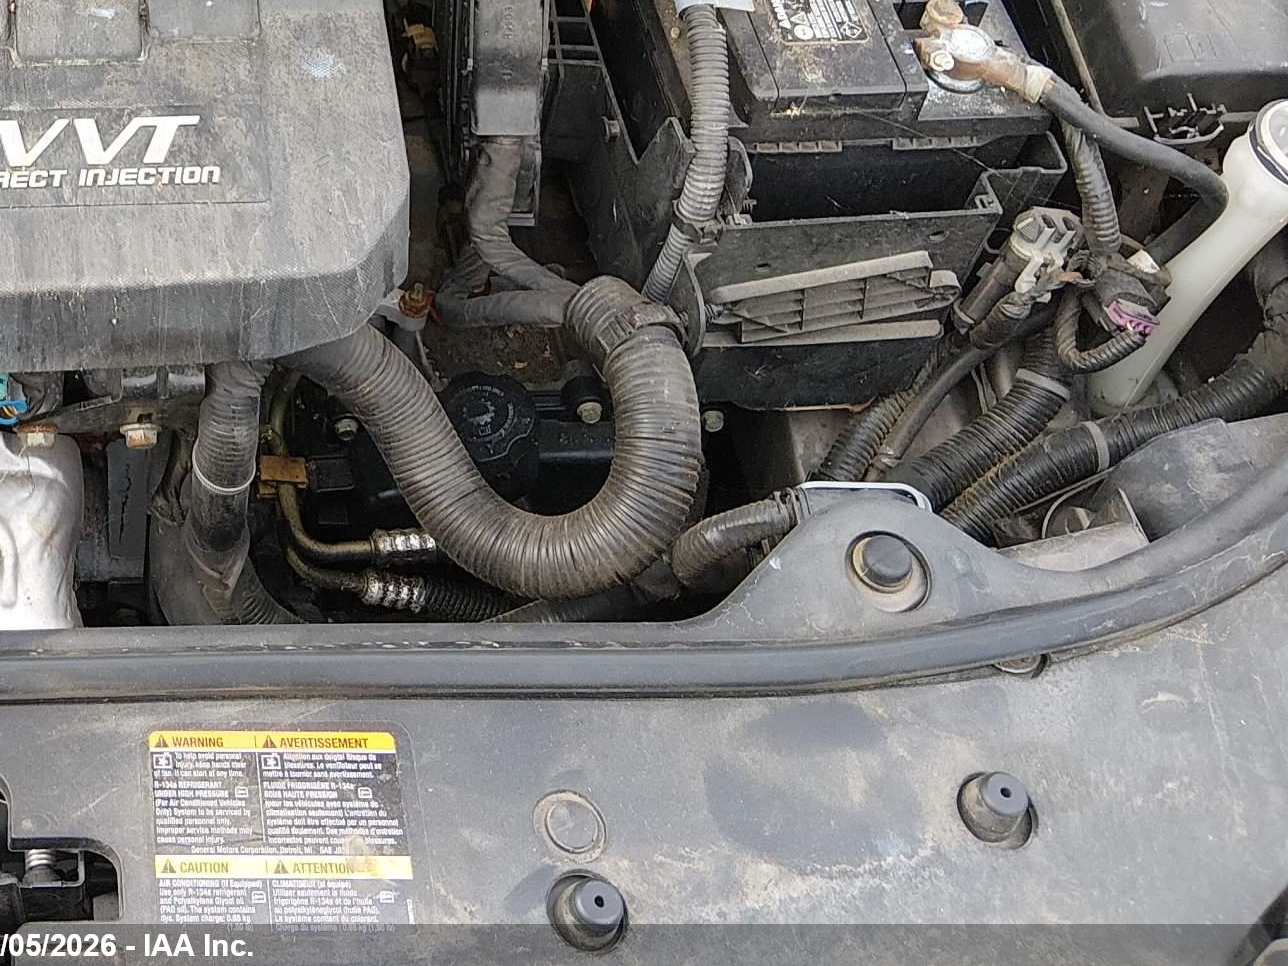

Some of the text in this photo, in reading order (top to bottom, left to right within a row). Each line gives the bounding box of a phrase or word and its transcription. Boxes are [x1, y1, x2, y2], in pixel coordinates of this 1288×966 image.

[78, 165, 221, 187] INJECTION
[172, 737, 224, 747] WARNING
[279, 738, 369, 748] AVERTISSEMENT
[184, 753, 196, 761] help
[154, 790, 228, 798] UNDER HIGH PRESSURE
[174, 808, 196, 816] System
[216, 808, 242, 816] serviced
[243, 808, 250, 817] by
[156, 818, 184, 826] qualified
[184, 818, 216, 826] personnel
[178, 836, 204, 844] personal
[191, 846, 216, 854] General
[217, 846, 238, 854] Motors
[180, 862, 229, 874] CAUTION
[293, 862, 356, 874] ATTENTION
